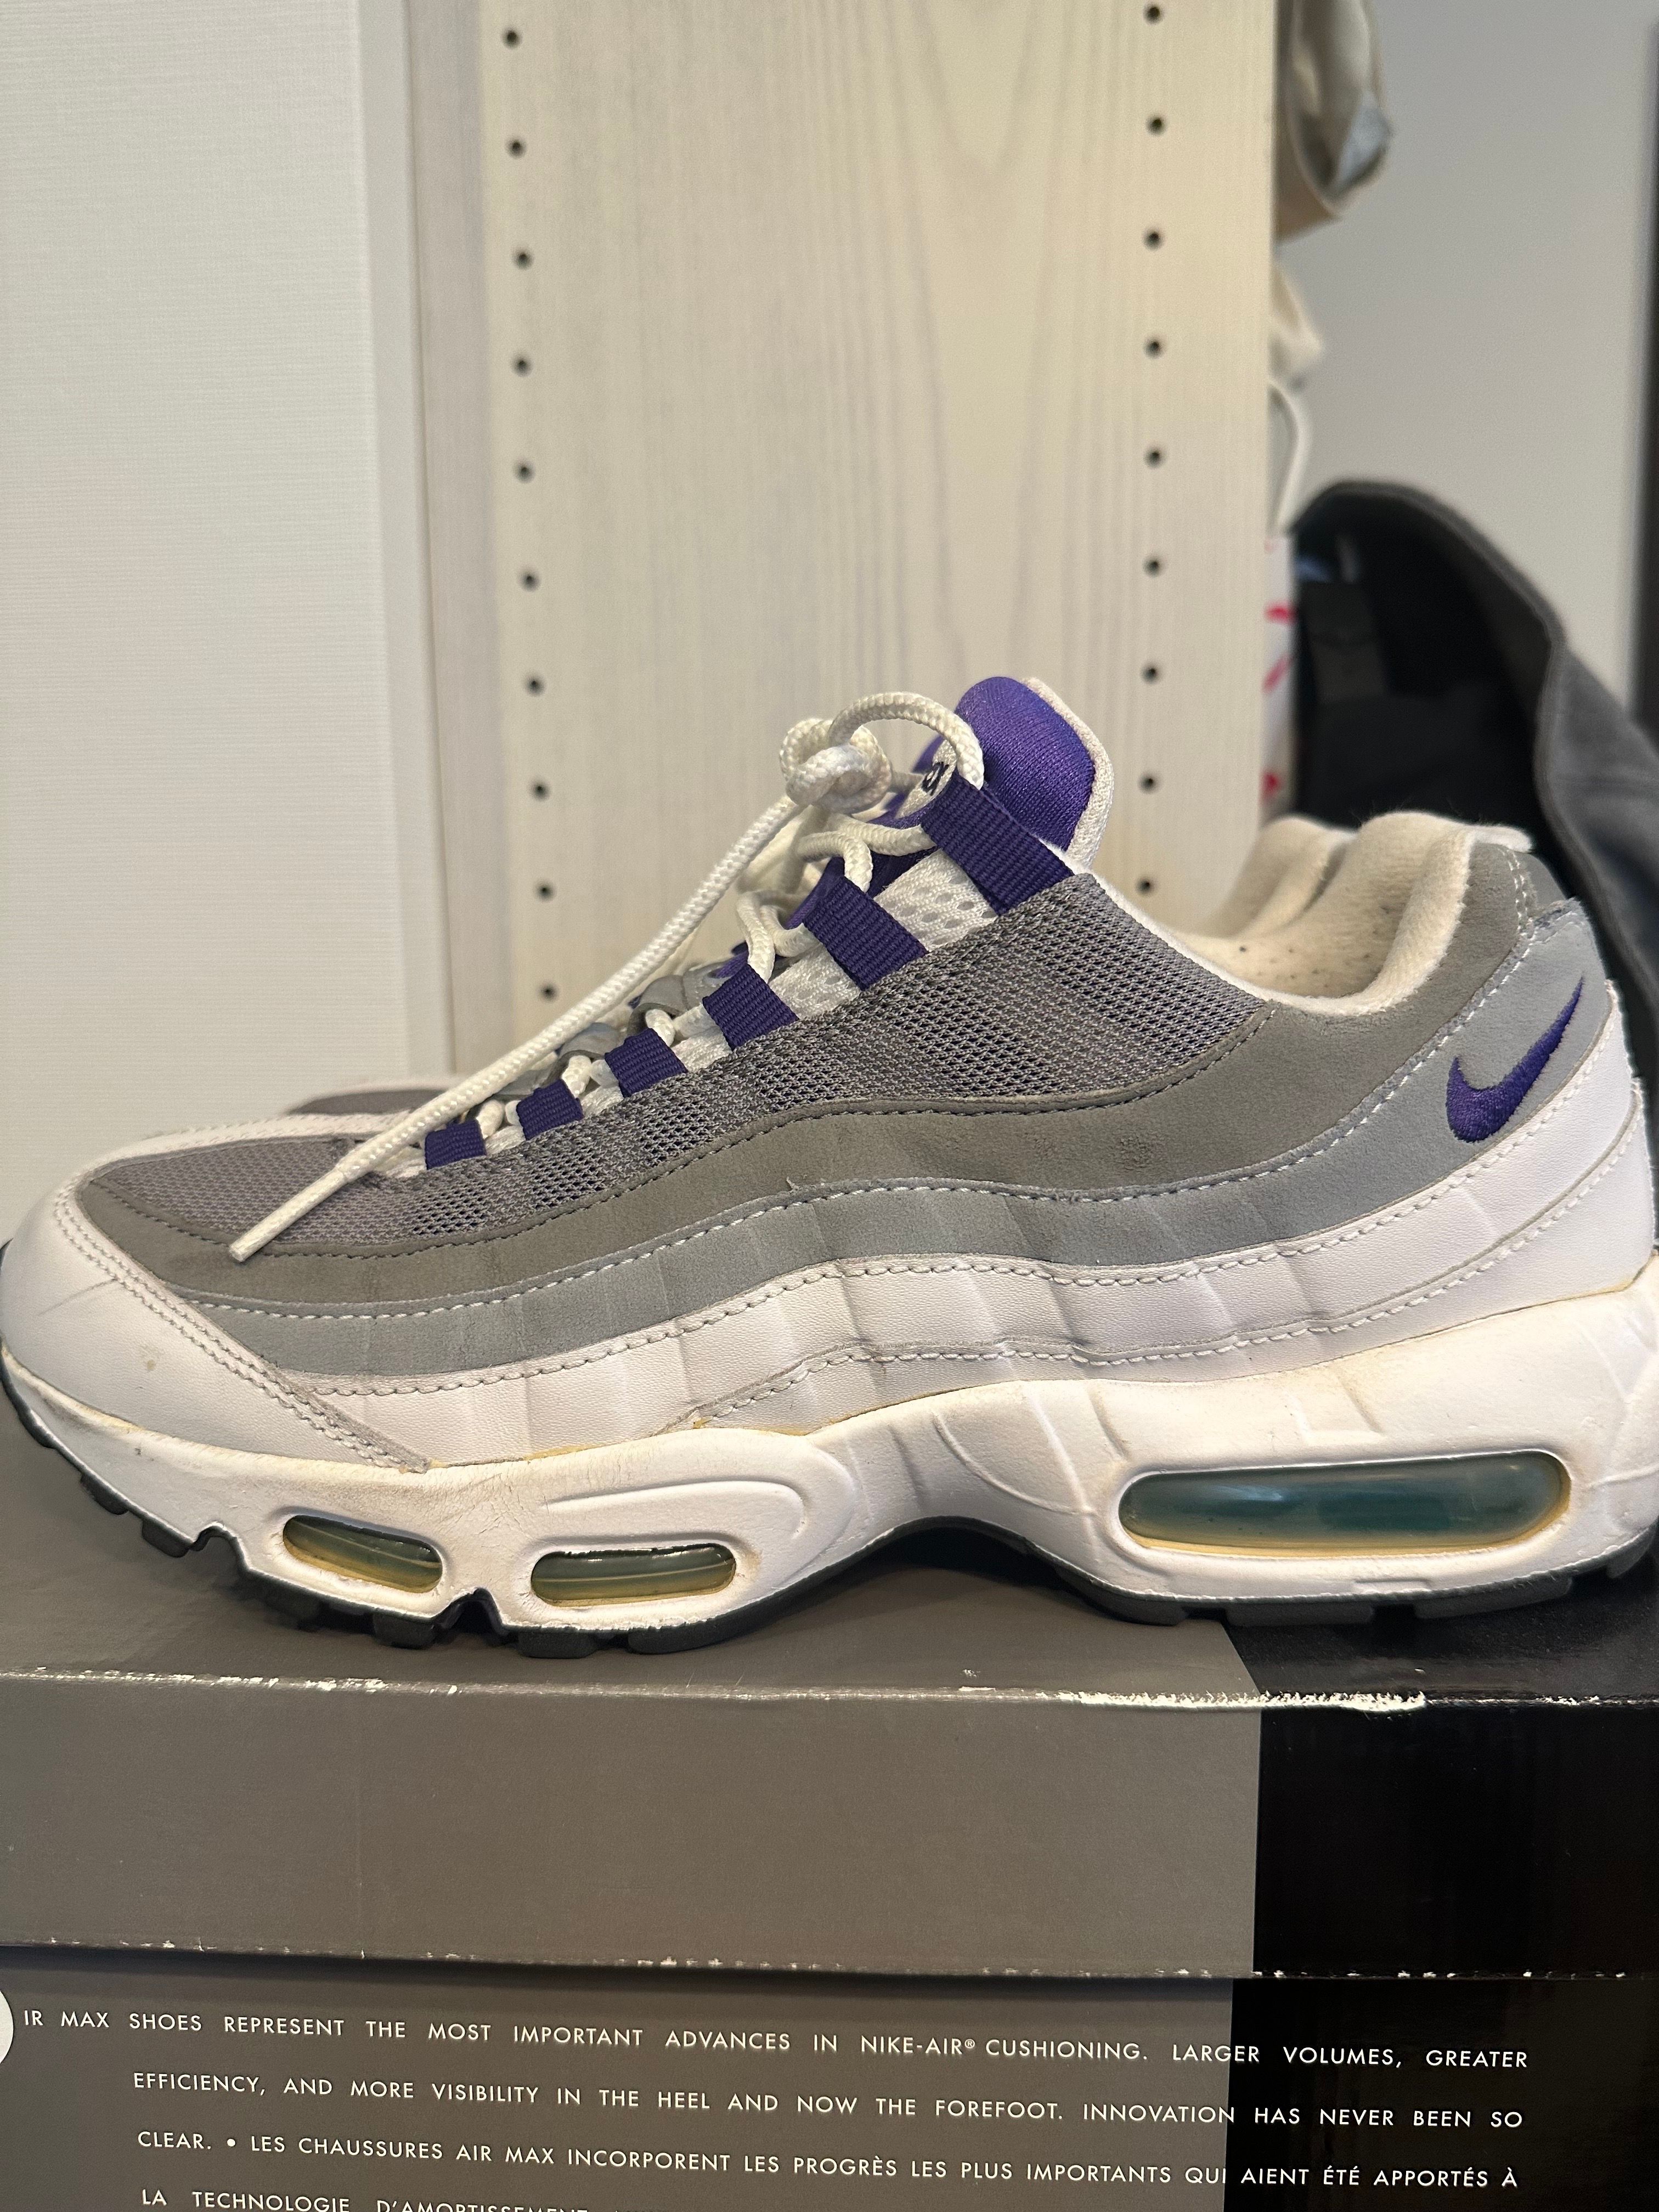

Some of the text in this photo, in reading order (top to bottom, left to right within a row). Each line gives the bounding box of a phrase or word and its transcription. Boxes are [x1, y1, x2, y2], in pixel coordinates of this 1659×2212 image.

[24, 2009, 44, 2027] IR
[60, 2010, 110, 2028] MAX
[129, 2012, 202, 2032] SHOES
[223, 2016, 345, 2036] REPRESENT
[365, 2020, 406, 2039] THE
[427, 2022, 492, 2042] MOST
[513, 2025, 644, 2047] IMPORTANT
[664, 2029, 791, 2052] ADVANCES
[813, 2034, 838, 2053] IN
[985, 2038, 1148, 2061] CUSHIONING.
[1172, 2044, 1260, 2064] LARGER
[1282, 2046, 1402, 2069] VOLUMES,
[1425, 2049, 1528, 2069] GREATER
[133, 2072, 1523, 2129] EFFICIENCY, AND MORE VISIBILITY IN THE HEEL AND NOW THE FOREFOOT. INNOVATION HAS NEVER BEEN SO
[137, 2130, 1518, 2189] CLEAR. LES CHAUSSURES AIR MAX INCORPORENT LES PROGRÈS LES PLUS IMPORTANTS QUI AIENT ÉTÉ APPORTÉS À
[142, 2188, 168, 2207] LA
[191, 2191, 350, 2212] TECHNOLOGIE
